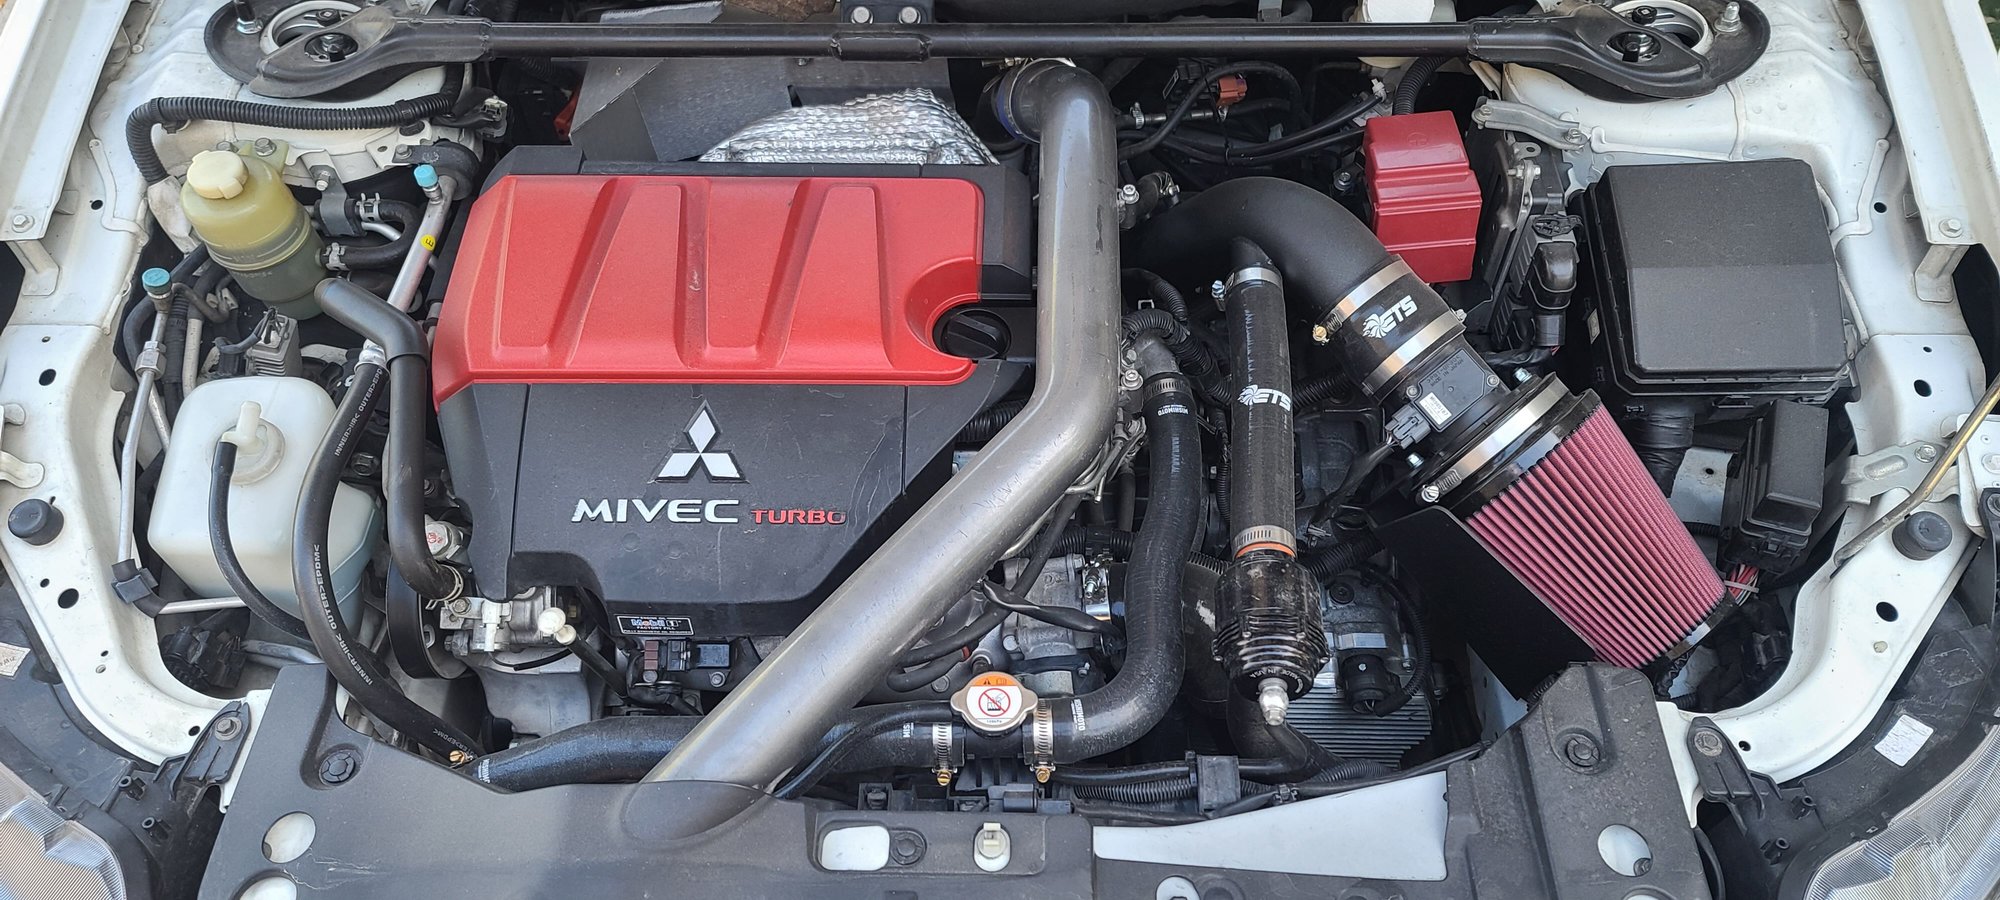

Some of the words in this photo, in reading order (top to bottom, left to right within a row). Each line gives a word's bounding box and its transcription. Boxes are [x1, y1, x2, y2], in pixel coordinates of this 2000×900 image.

[1370, 295, 1418, 335] ETS
[1245, 387, 1291, 411] ETS
[571, 499, 739, 523] MIVEC
[751, 509, 847, 524] TURBO
[631, 619, 665, 627] Mobil
